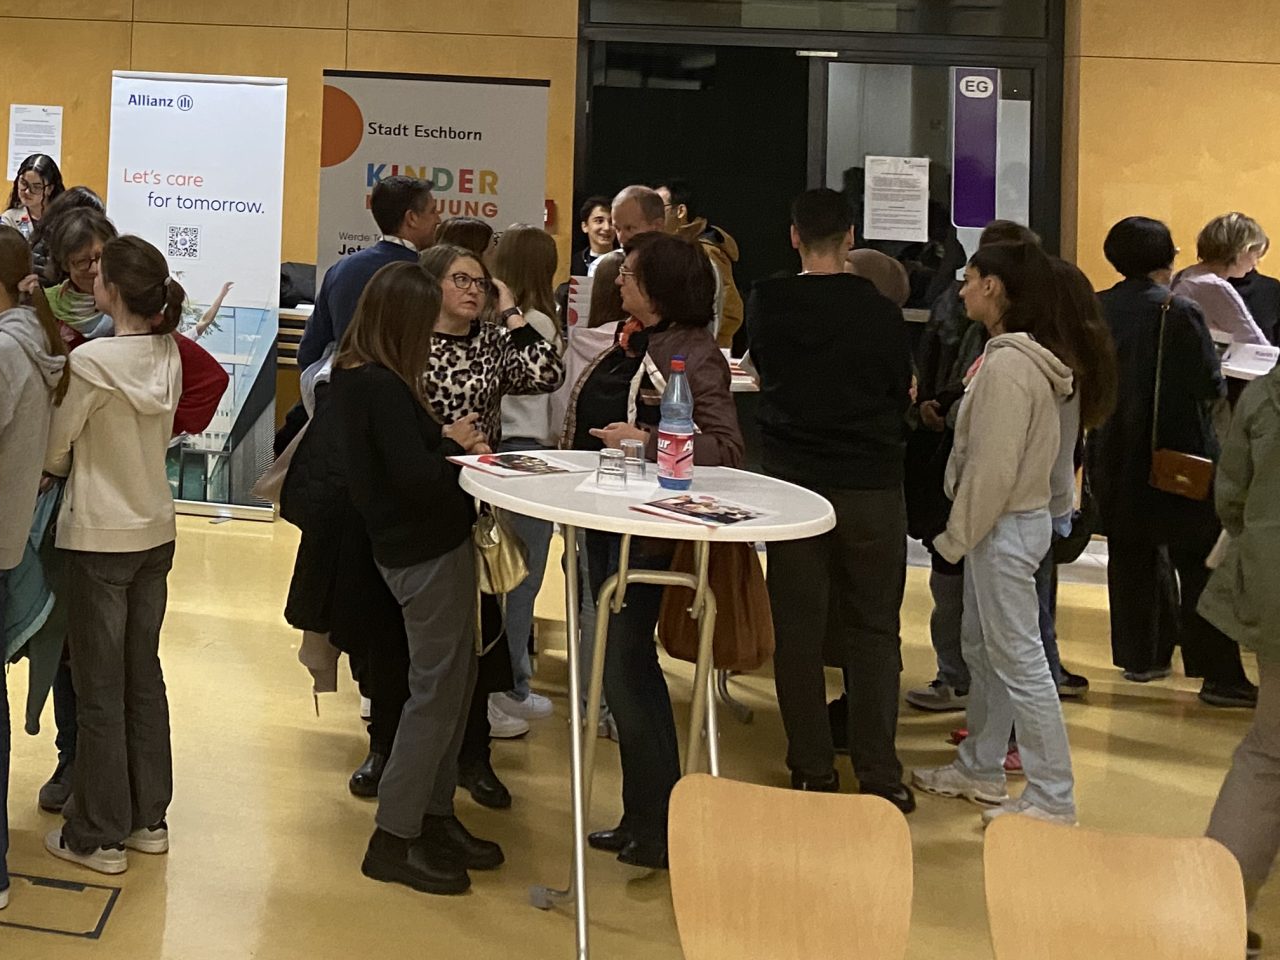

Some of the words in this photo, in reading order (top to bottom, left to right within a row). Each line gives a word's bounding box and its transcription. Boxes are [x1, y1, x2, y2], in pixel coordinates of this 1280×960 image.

[965, 80, 989, 92] EG
[128, 94, 174, 108] Allianz
[368, 122, 409, 137] Stadt
[414, 125, 482, 141] Eschborn
[166, 173, 204, 187] care
[148, 191, 171, 208] for
[177, 195, 265, 214] tomorrow.
[338, 231, 370, 241] Werde
